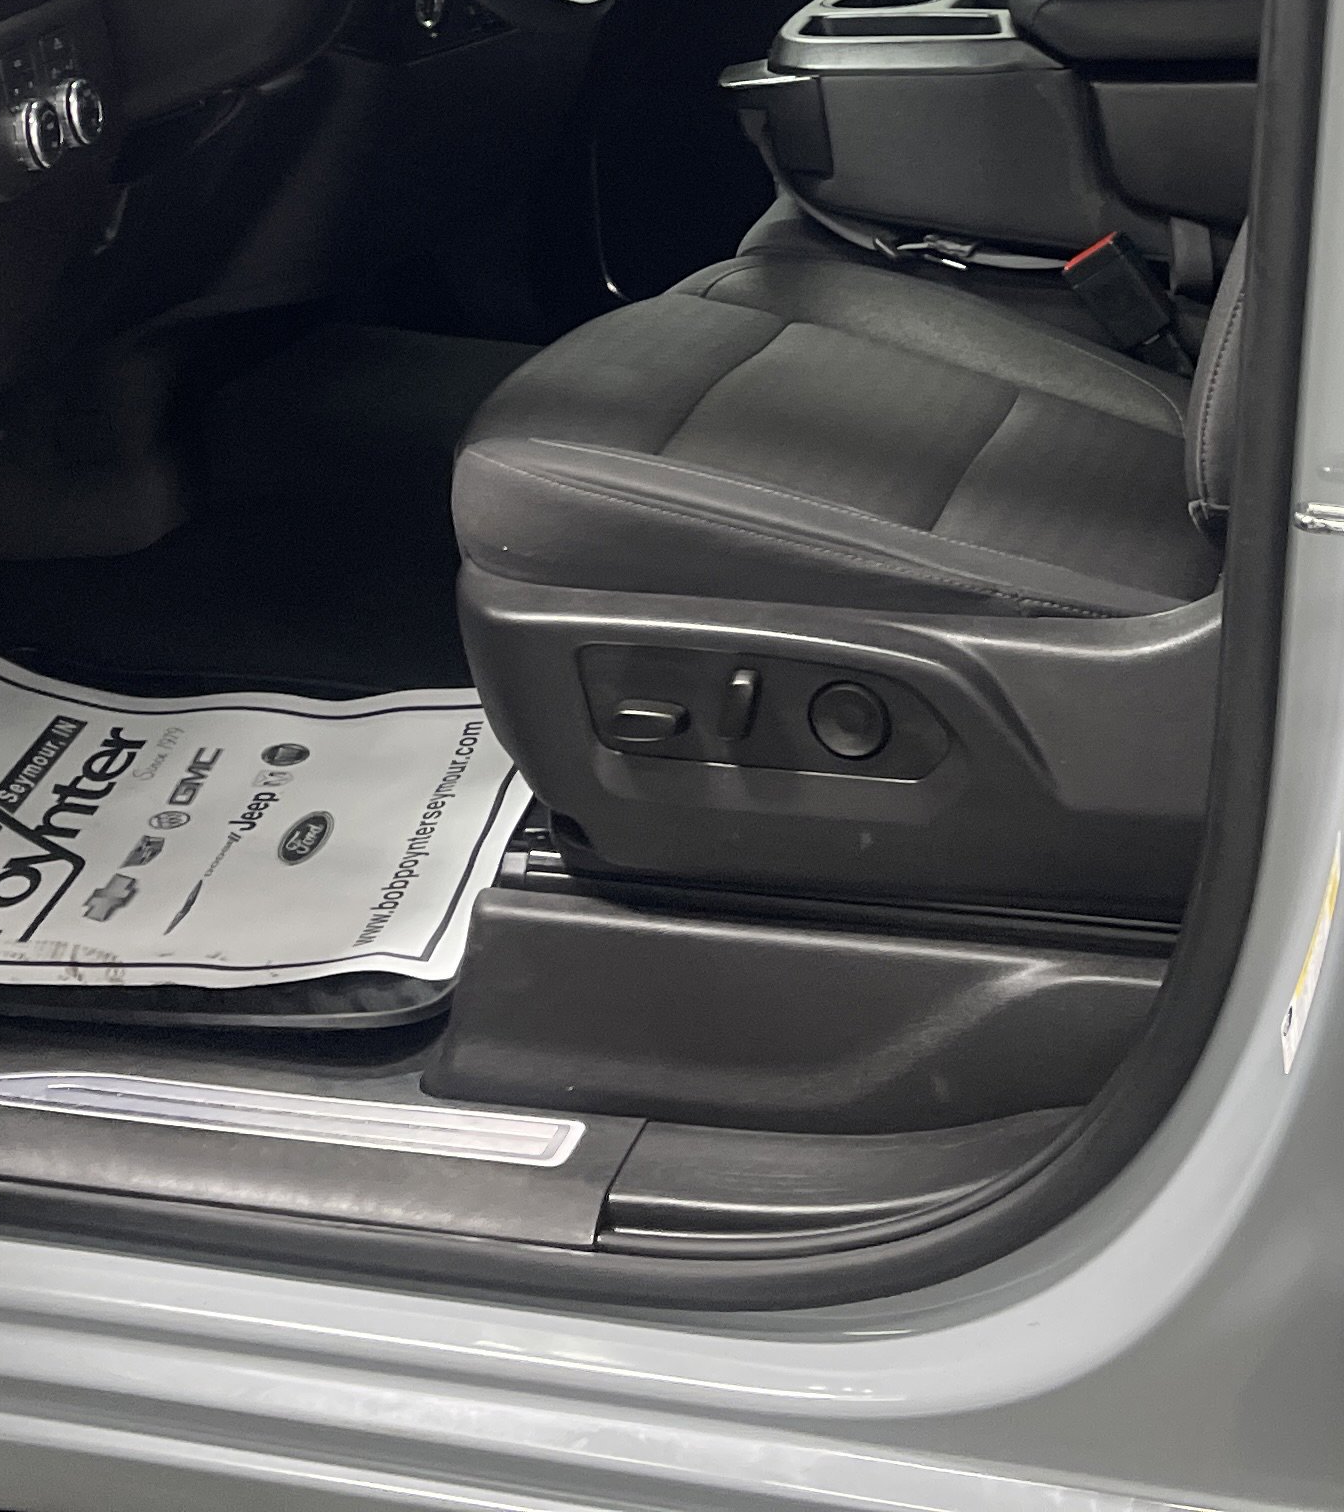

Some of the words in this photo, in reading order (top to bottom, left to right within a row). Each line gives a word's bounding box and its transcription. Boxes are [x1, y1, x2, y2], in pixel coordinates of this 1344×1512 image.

[52, 719, 78, 738] IN
[168, 747, 224, 805] GMC
[228, 792, 279, 831] Jeep
[286, 823, 324, 855] Ford
[352, 720, 485, 948] www.bobpoynterseymour.com
